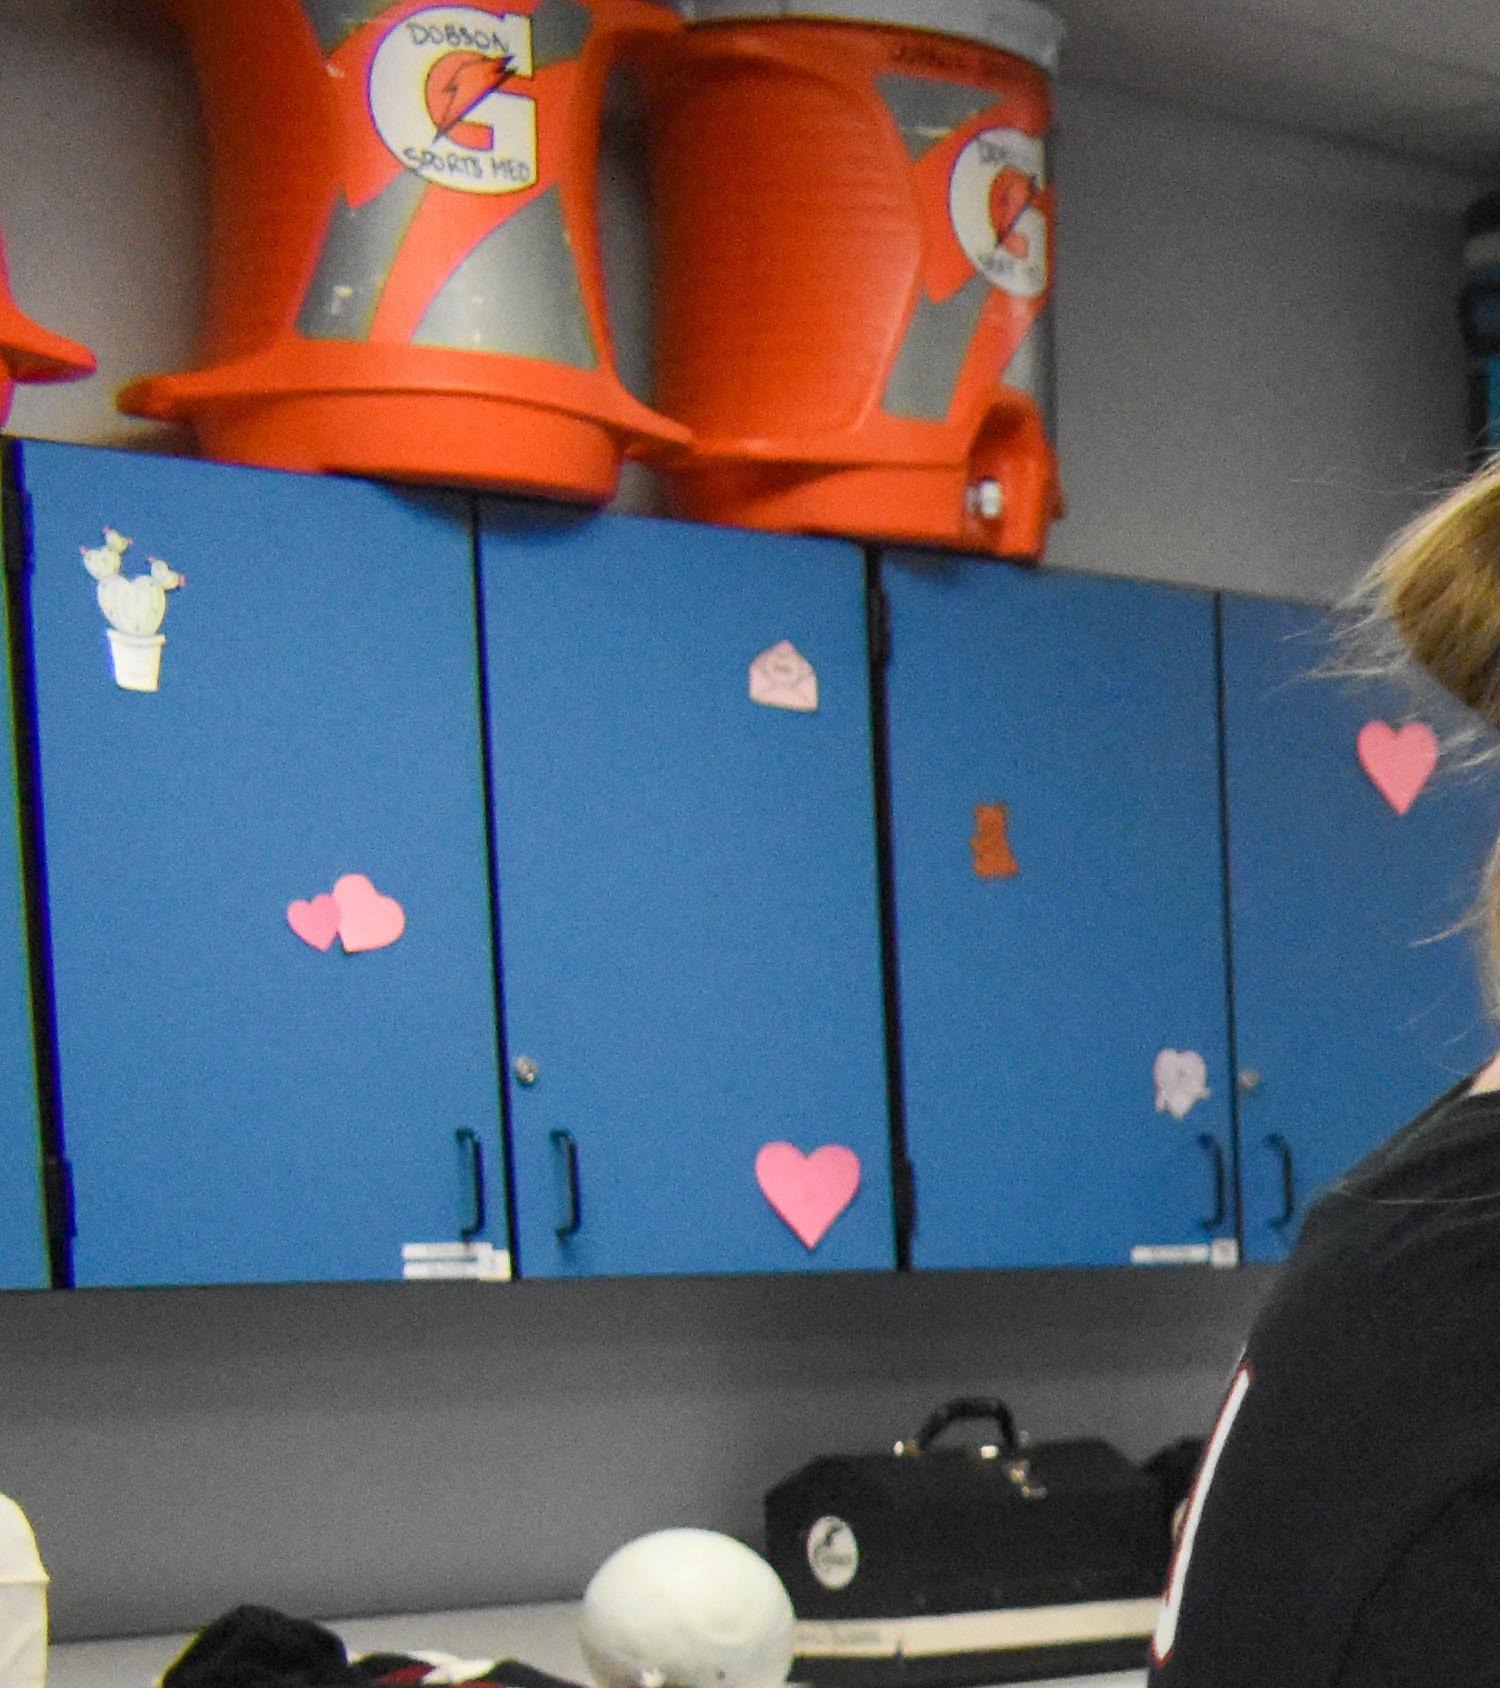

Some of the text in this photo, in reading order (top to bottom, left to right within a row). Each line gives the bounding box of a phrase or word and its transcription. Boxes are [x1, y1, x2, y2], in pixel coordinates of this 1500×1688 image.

[406, 22, 509, 52] DOBSON
[404, 147, 530, 181] SPORTS MED
